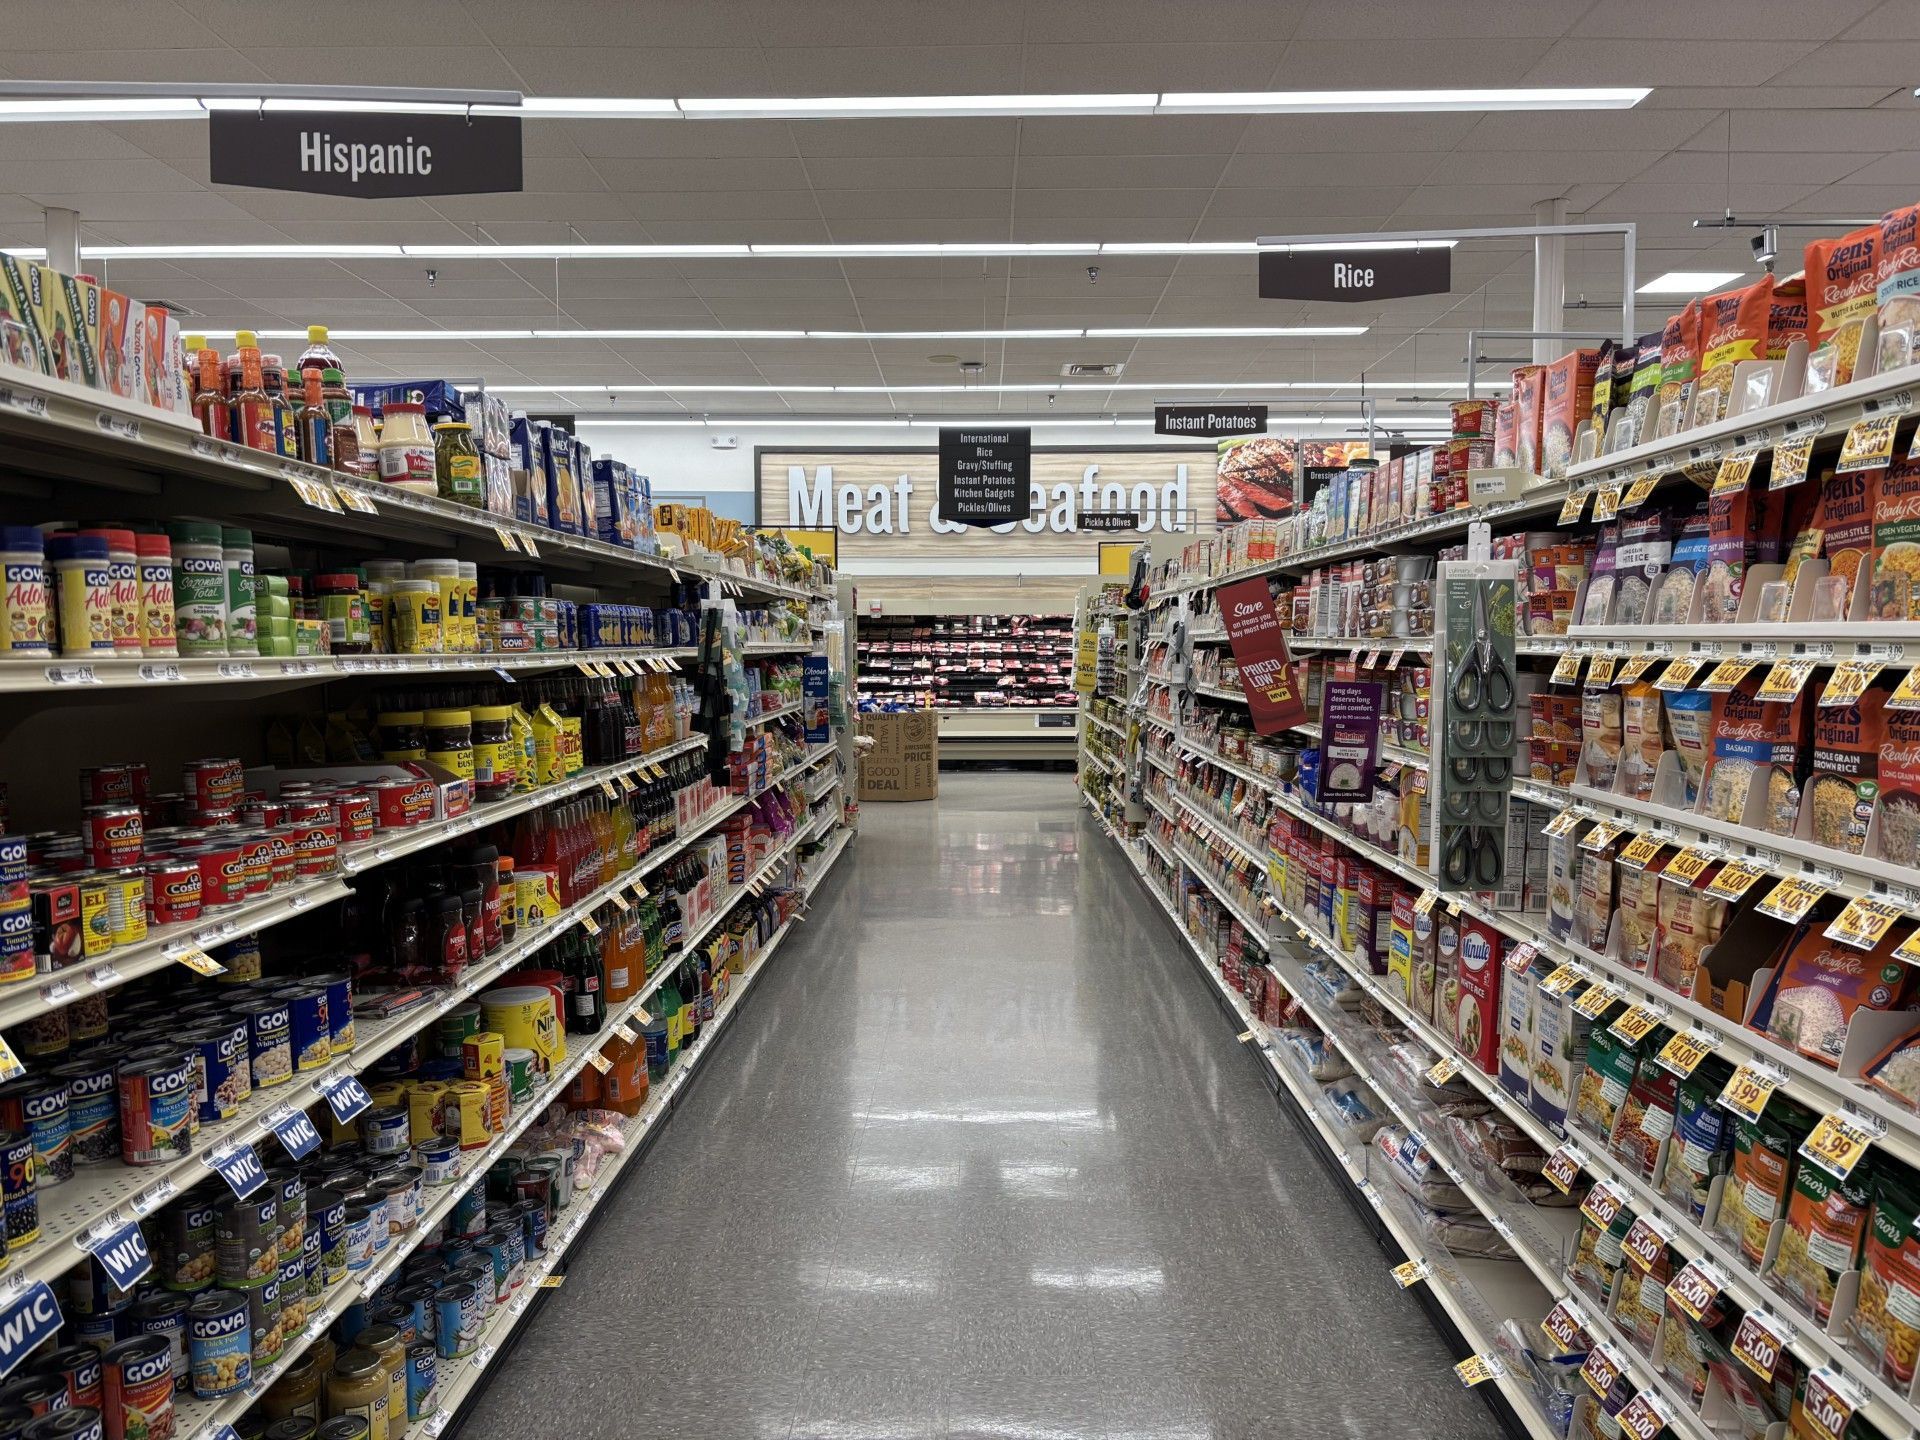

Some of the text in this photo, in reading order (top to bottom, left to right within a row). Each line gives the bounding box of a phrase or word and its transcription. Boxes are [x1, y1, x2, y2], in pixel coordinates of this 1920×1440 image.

[300, 131, 432, 182] Hispanic
[1827, 237, 1875, 267] Ben's
[1334, 263, 1374, 288] Rice
[1826, 256, 1872, 282] Original
[1824, 283, 1860, 304] Ready
[1165, 414, 1257, 429] Instant Potatoes
[960, 433, 1009, 443] International
[976, 447, 993, 457] Rice
[957, 460, 1013, 472] Gravy/Stuffing
[954, 475, 1016, 485] Instant Potatoes
[788, 465, 913, 534] Meat
[988, 464, 1187, 534] eafood
[954, 489, 1015, 500] Kitchen Gadgets
[957, 502, 1011, 512] Pickles/Olives
[1824, 496, 1865, 520] Original
[1084, 517, 1131, 527] Pickle & Olives
[1825, 526, 1870, 542] SPANISH STYLE
[184, 560, 222, 572] GOYA
[193, 588, 219, 598] Total
[1233, 601, 1264, 617] Save
[1242, 616, 1259, 627] items
[1259, 613, 1271, 622] you
[1244, 625, 1260, 635] most
[1260, 620, 1277, 630] often
[502, 638, 522, 648] GOYA
[1820, 644, 1833, 655] 3.09
[1241, 659, 1281, 677] PRICED
[1248, 673, 1274, 688] LOW
[1255, 684, 1277, 693] EVERY
[1270, 691, 1287, 700] MVP
[1331, 687, 1346, 695] long
[1347, 704, 1374, 712] comfort.
[1356, 696, 1371, 704] long
[1724, 707, 1764, 720] Original
[1716, 720, 1773, 739] Ready Rice
[880, 723, 889, 754] VALUE
[1725, 743, 1754, 753] BASMATI
[904, 751, 932, 762] PRICE
[1834, 753, 1860, 764] GRAIN
[1880, 744, 1912, 769] Ready
[866, 767, 900, 777] GOOD
[1837, 764, 1858, 773] RICE
[1882, 770, 1915, 780] LONG GRAIN
[867, 780, 900, 790] DEAL
[130, 818, 140, 828] La
[1768, 852, 1781, 864] 3.09
[190, 873, 199, 883] La
[1830, 868, 1843, 882] 3.09
[1795, 880, 1825, 896] SALE!
[1866, 900, 1901, 919] SALE!
[1462, 938, 1490, 960] Minute
[1816, 972, 1842, 985] JASMINE
[1461, 978, 1485, 998] WHITE RICE
[1668, 1041, 1697, 1066] 2/4.00
[1750, 1070, 1775, 1091] SALE!
[332, 1081, 365, 1112] WIC
[1731, 1078, 1760, 1104] 3.99
[282, 1118, 315, 1149] WIC
[1838, 1120, 1869, 1145] SALE!
[1872, 1118, 1887, 1133] 4.49
[1402, 1138, 1418, 1159] WIC
[1816, 1129, 1852, 1159] 3.99
[9, 1157, 34, 1188] 90
[225, 1154, 259, 1187] WIC
[1551, 1156, 1573, 1185] 4/5.00
[1590, 1192, 1615, 1222] 4/5.00
[1630, 1229, 1657, 1261] 4/5.00
[104, 1232, 147, 1276] WIC
[1677, 1273, 1710, 1309] 4/5.00
[0, 1292, 54, 1356] WIC
[147, 1318, 176, 1330] GOYA
[193, 1312, 245, 1337] GOYA
[1551, 1312, 1573, 1344] 4/5.00
[1741, 1328, 1775, 1368] 4/5.00
[127, 1350, 171, 1381] GOYA
[1588, 1356, 1613, 1390] 4/5.00
[1807, 1387, 1843, 1434] 4/5.00
[1628, 1404, 1656, 1440] 4/5.00
